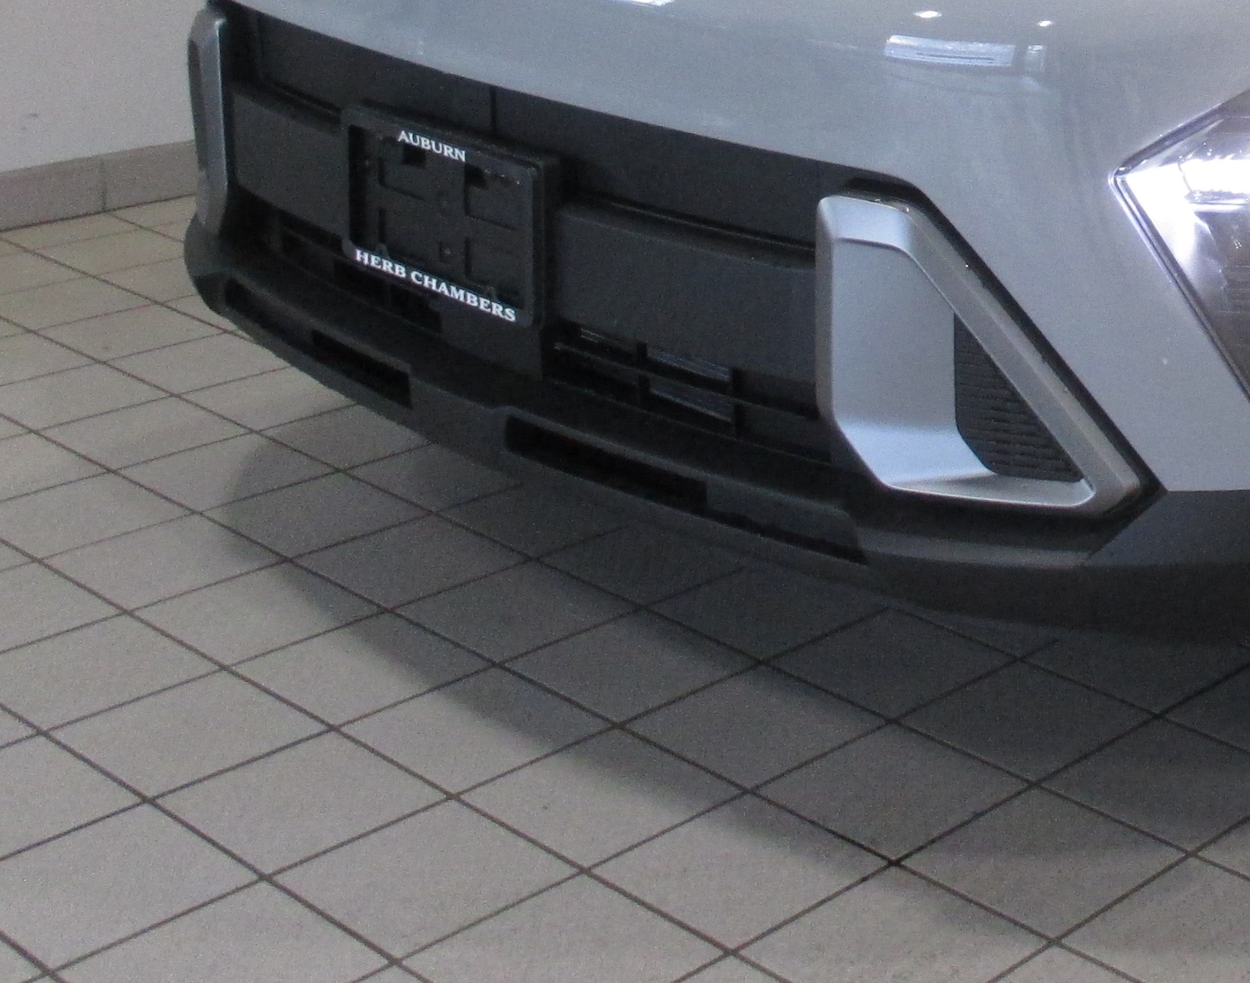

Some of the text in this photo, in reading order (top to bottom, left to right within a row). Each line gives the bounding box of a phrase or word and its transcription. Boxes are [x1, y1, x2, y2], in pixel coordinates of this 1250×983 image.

[398, 130, 467, 162] AUBURN
[355, 249, 516, 323] HERB CHAMBERS
